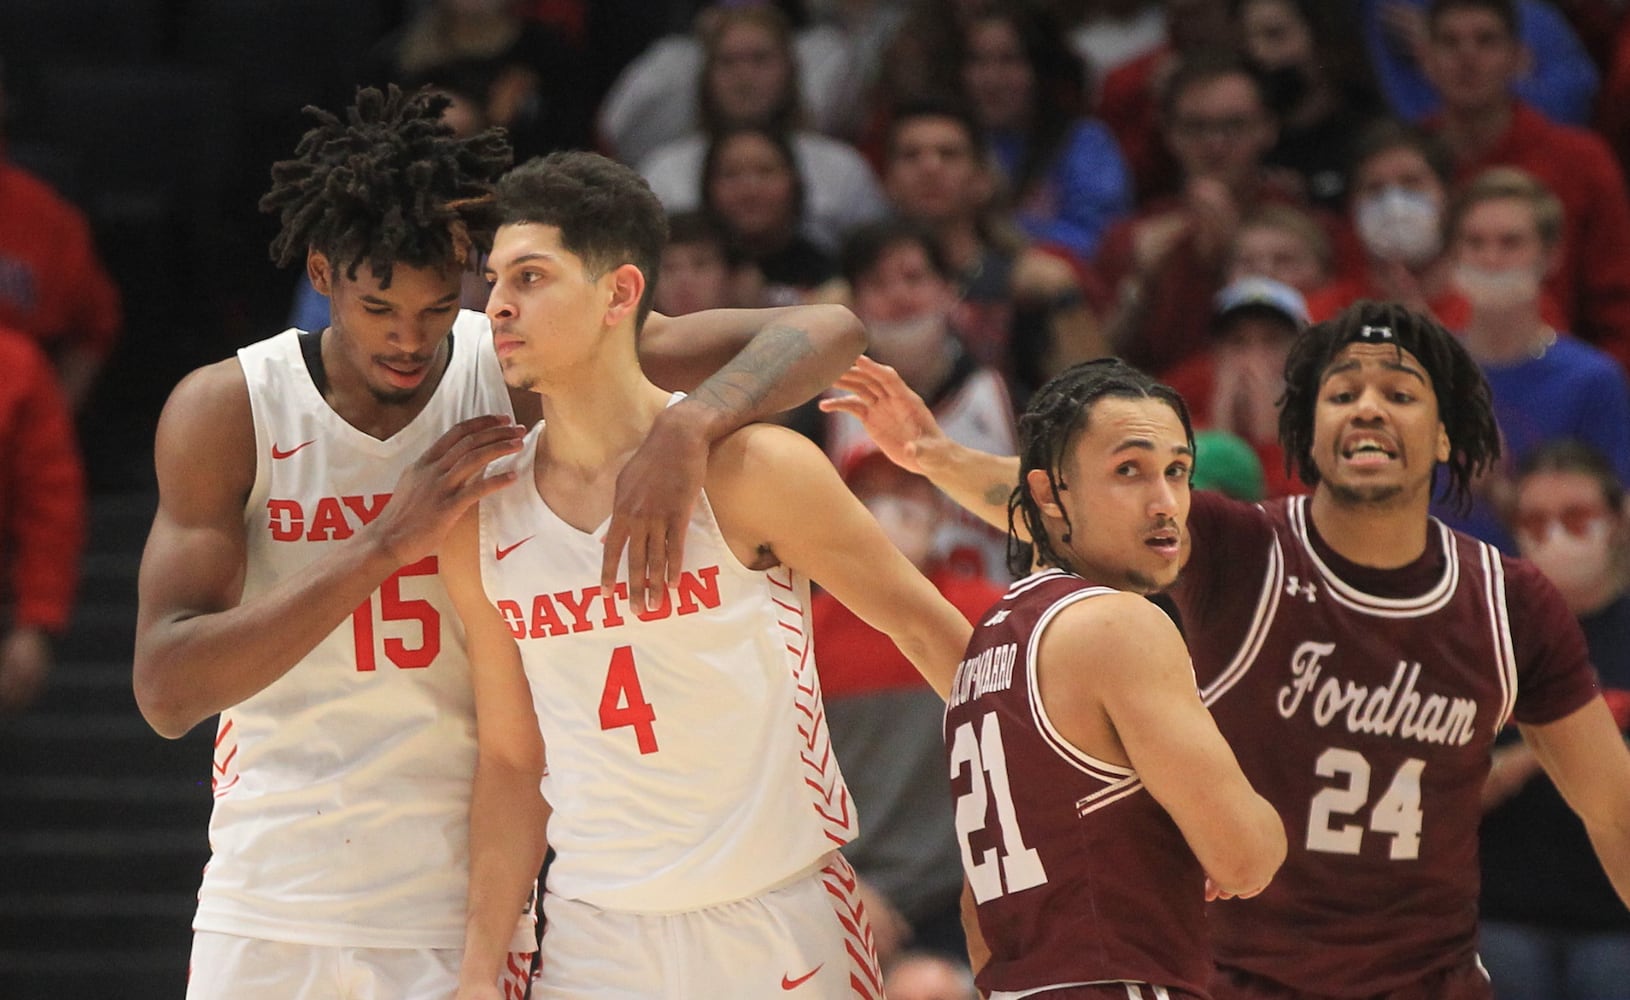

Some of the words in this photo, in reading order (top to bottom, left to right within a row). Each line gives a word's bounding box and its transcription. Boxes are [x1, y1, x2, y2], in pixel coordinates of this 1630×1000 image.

[353, 555, 440, 672] 15
[598, 645, 659, 754] 4
[1277, 641, 1477, 746] Fordham
[950, 711, 1049, 905] 21
[1306, 747, 1427, 860] 24
